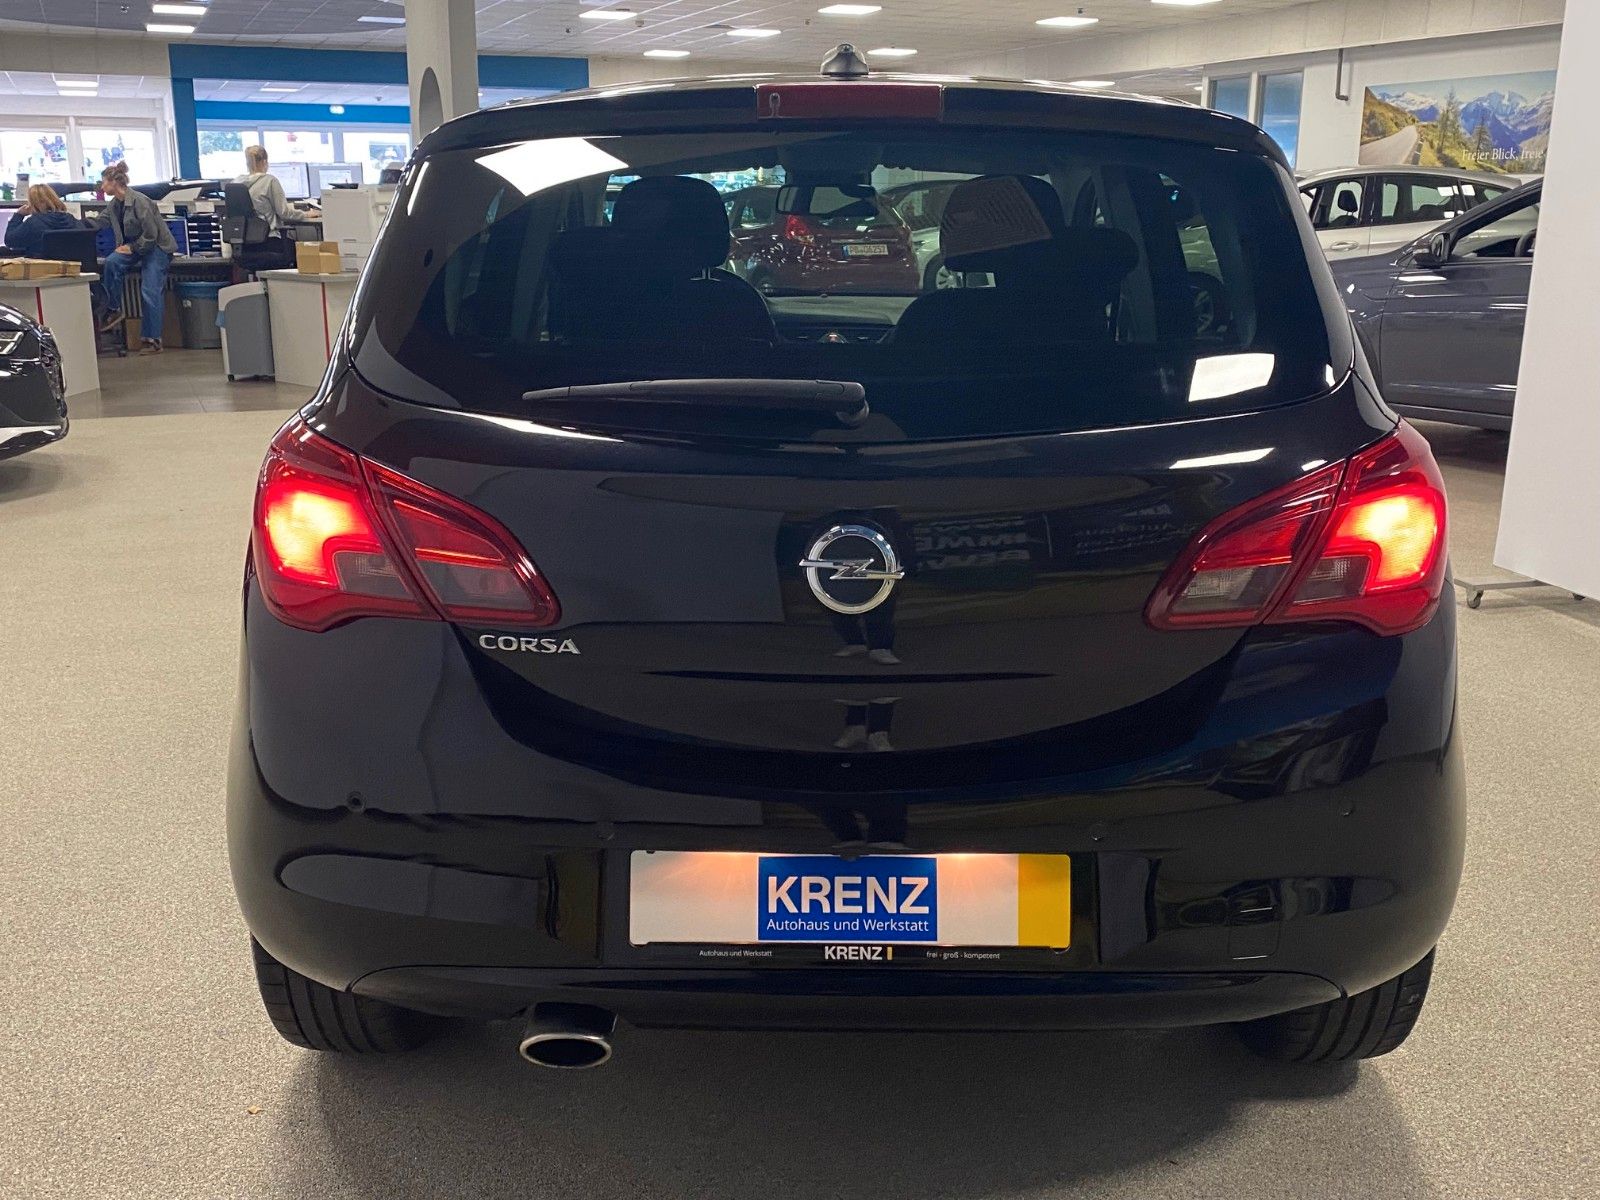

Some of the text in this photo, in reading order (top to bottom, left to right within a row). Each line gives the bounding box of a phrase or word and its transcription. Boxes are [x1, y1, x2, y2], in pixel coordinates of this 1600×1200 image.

[1462, 149, 1489, 160] Freier
[1491, 147, 1518, 160] Blick,
[479, 634, 581, 654] CORSA
[768, 876, 929, 914] KRENZ
[767, 918, 929, 932] Autohaus und Werkstatt
[699, 949, 728, 957] Autohaus
[729, 949, 742, 957] und
[824, 945, 883, 960] KRENZ
[943, 951, 959, 960] groß
[963, 952, 1000, 960] kompetent
